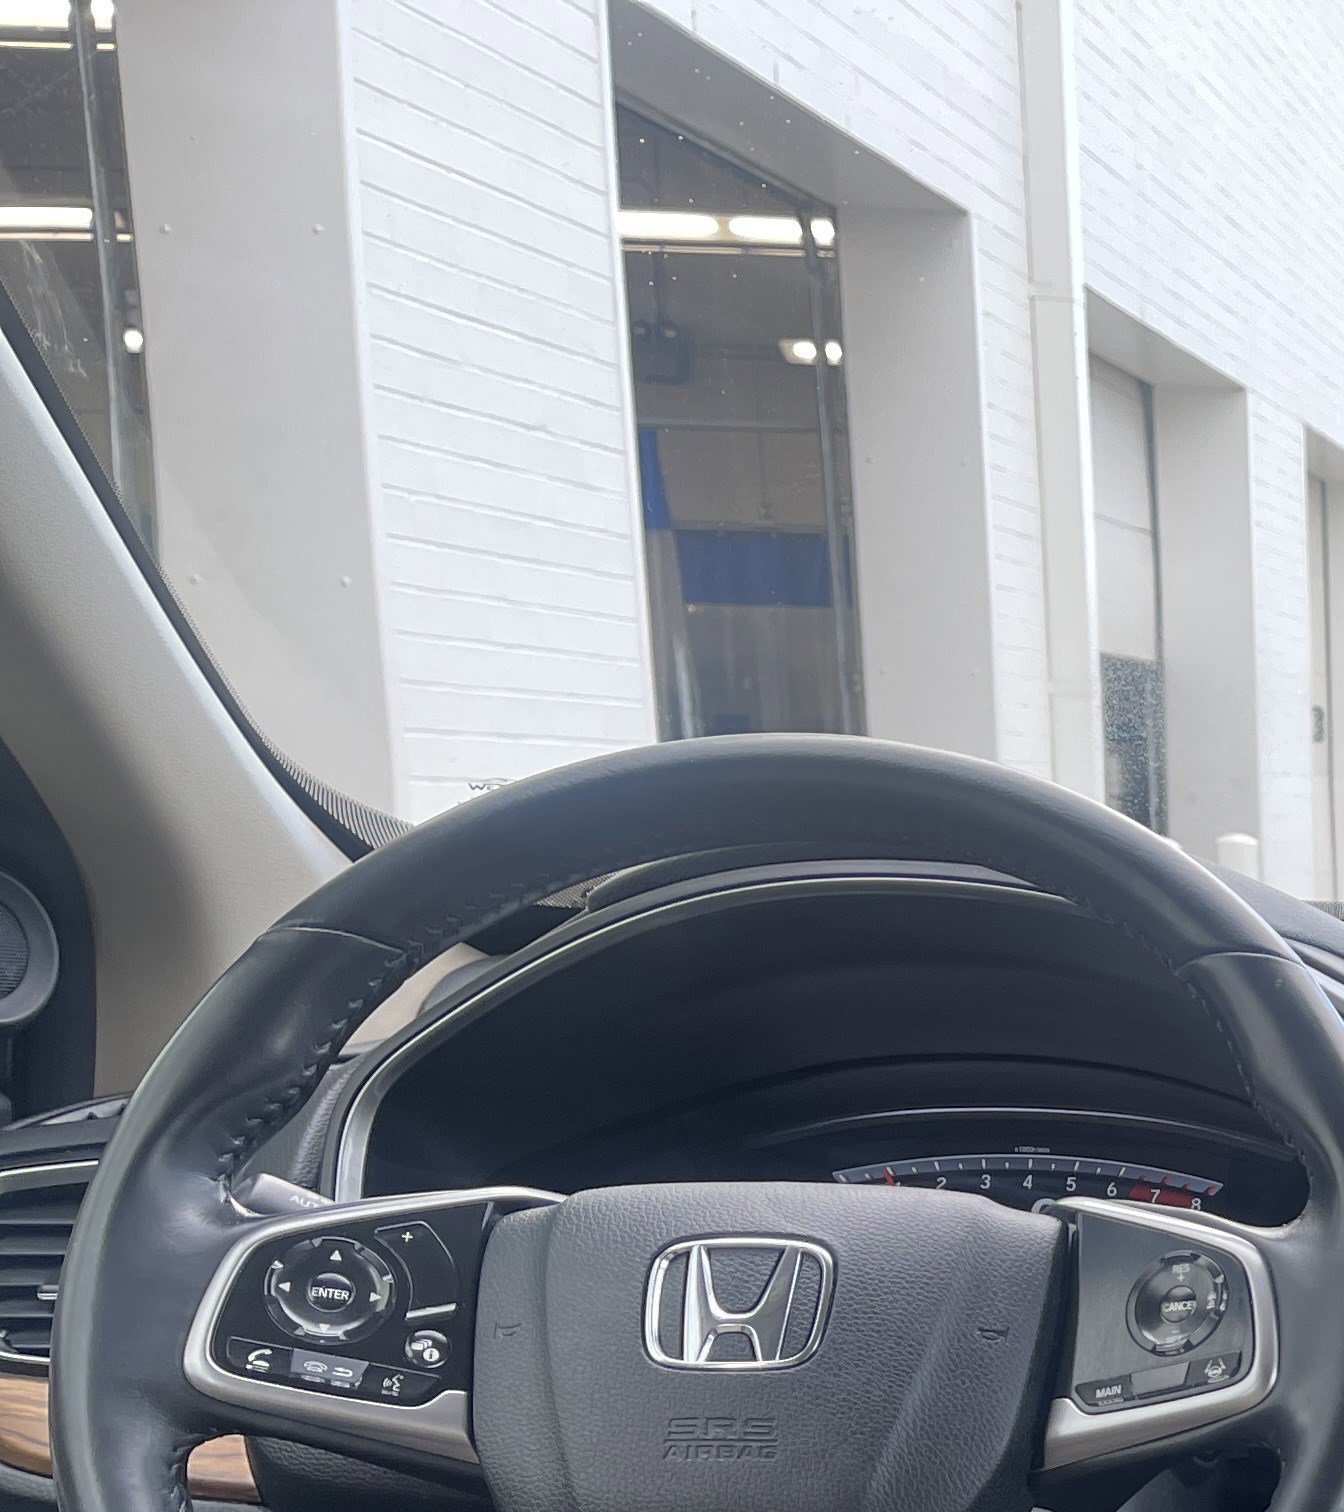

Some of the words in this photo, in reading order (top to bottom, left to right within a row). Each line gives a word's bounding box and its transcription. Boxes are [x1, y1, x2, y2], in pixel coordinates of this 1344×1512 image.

[979, 1174, 992, 1189] 3
[1022, 1174, 1034, 1189] 4
[1066, 1177, 1078, 1192] 5
[1106, 1182, 1118, 1197] 6
[1149, 1188, 1161, 1204] 7
[311, 1286, 350, 1301] ENTER
[1095, 1384, 1122, 1399] MAIN
[667, 1416, 777, 1437] SRS
[663, 1444, 779, 1462] AIRBAG
